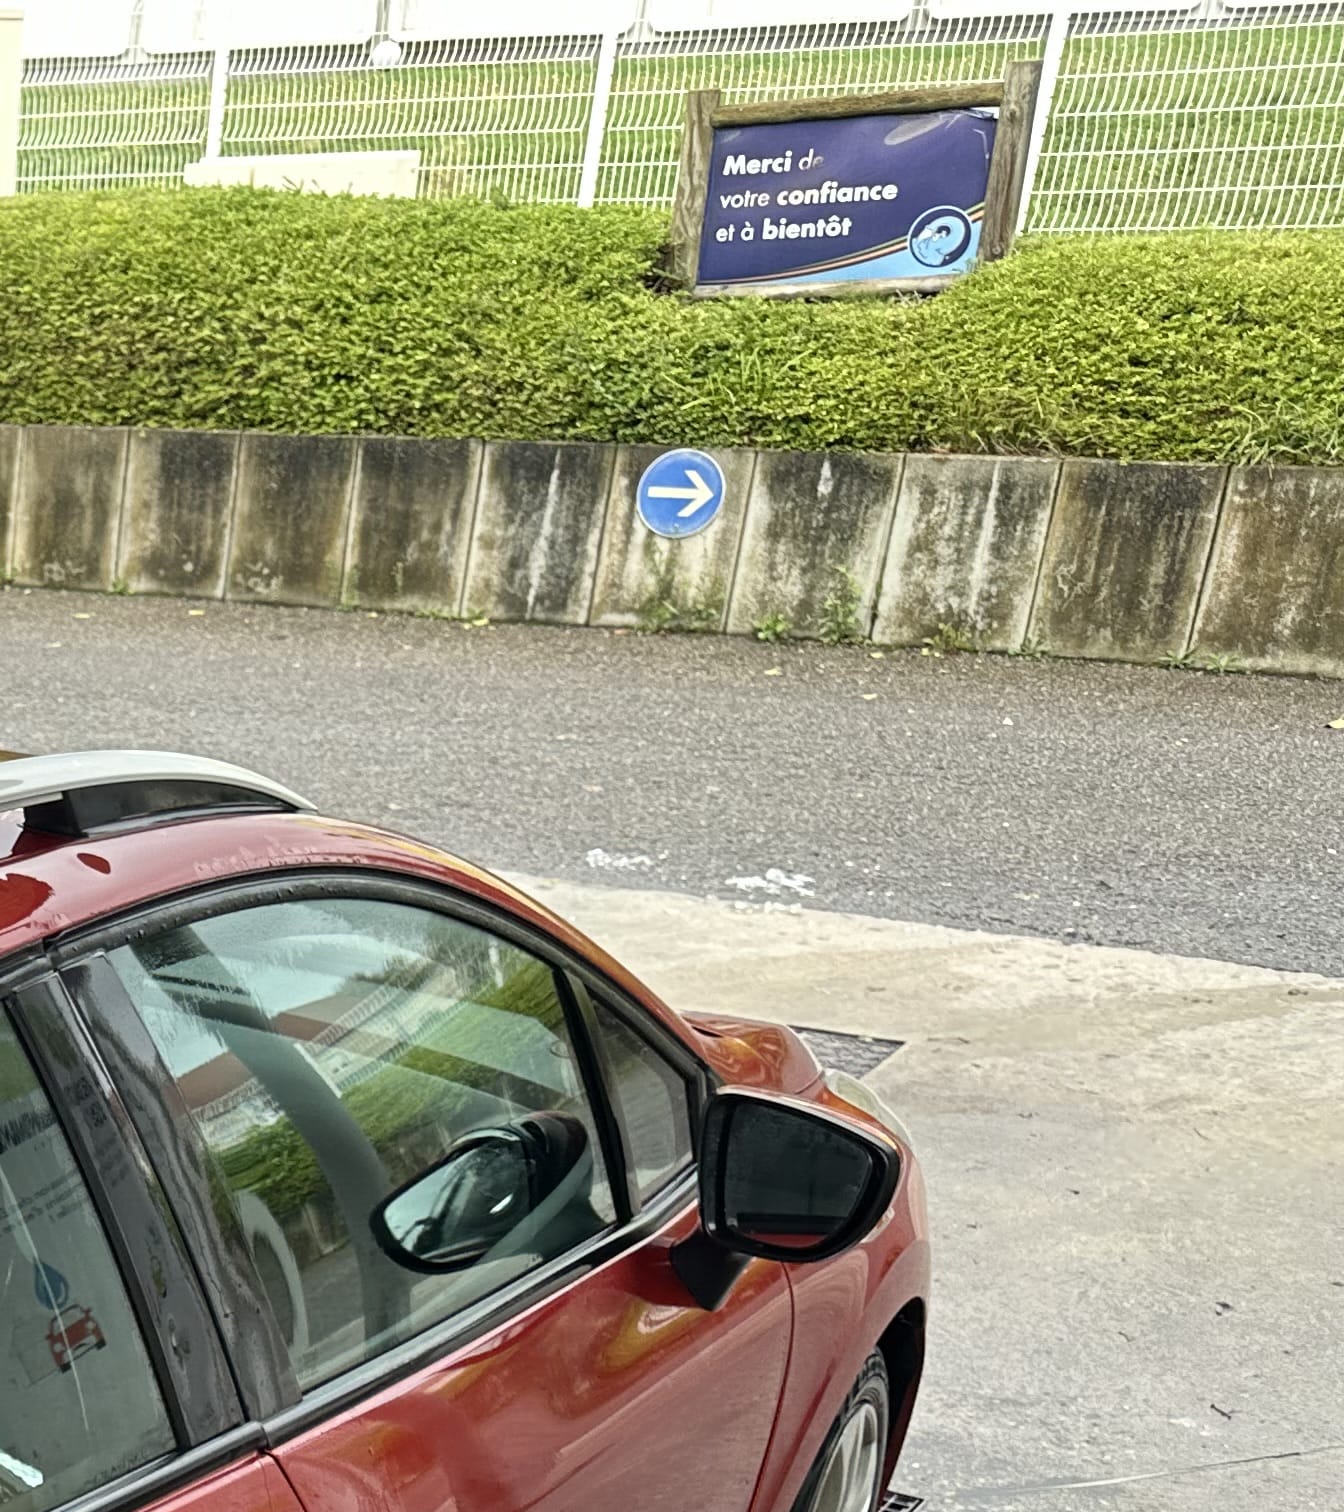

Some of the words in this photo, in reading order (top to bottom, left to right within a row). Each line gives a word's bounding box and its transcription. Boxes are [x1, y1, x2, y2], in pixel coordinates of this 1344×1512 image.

[722, 150, 793, 176] Merci
[798, 148, 824, 171] de
[719, 190, 770, 209] votre
[776, 180, 899, 206] confiance
[716, 224, 735, 242] et
[741, 221, 755, 241] à
[762, 214, 853, 241] bientôt
